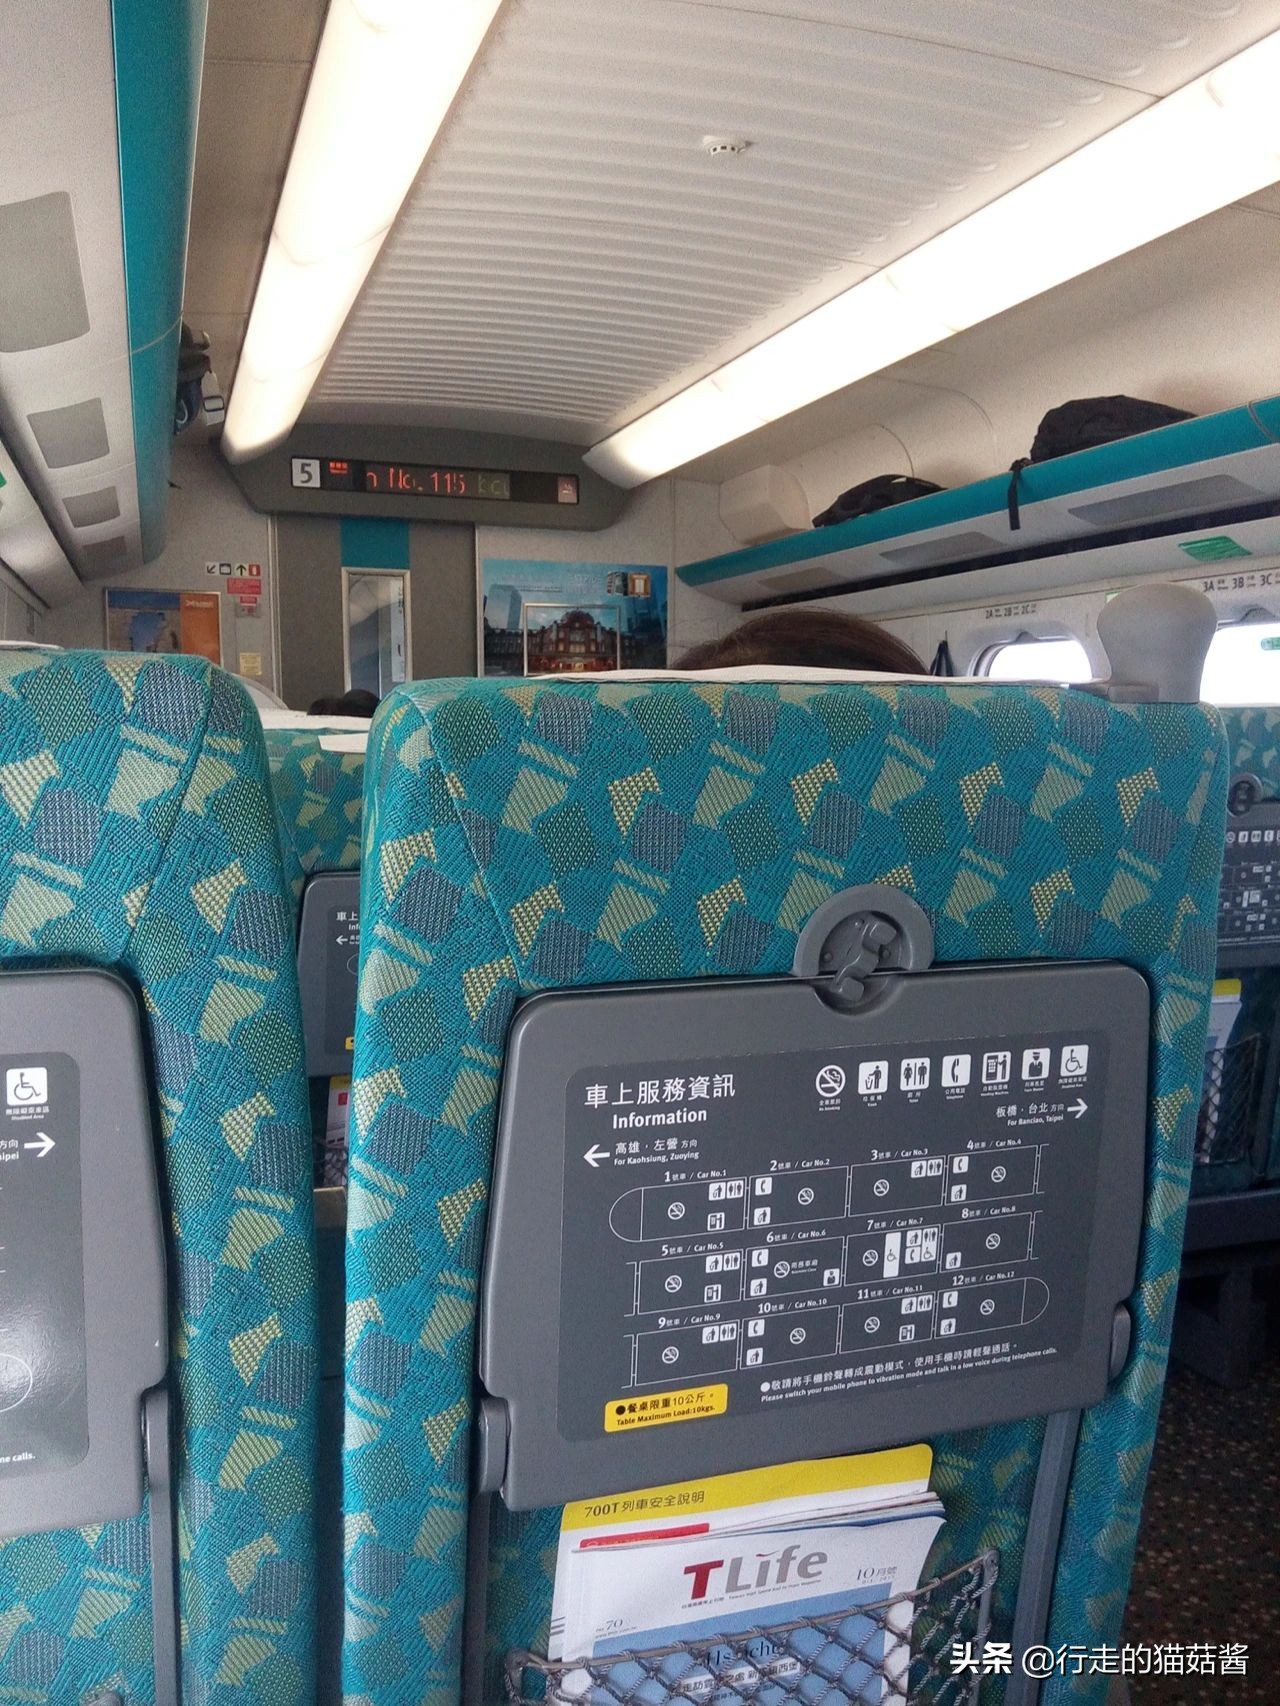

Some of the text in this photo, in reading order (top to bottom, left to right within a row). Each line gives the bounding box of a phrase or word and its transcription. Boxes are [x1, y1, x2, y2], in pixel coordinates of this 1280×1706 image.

[300, 462, 312, 483] 5
[430, 472, 466, 494] 115
[1232, 576, 1244, 590] 3B
[1260, 573, 1272, 586] 3C
[1203, 580, 1215, 592] 3A
[348, 923, 360, 931] Inf
[584, 1074, 736, 1109] 車上服務資訊
[612, 1108, 708, 1129] Information
[1046, 1113, 1064, 1122] Taipei
[681, 1139, 698, 1149] 方向
[614, 1151, 700, 1166] For Kaohsiung, Zuoying
[697, 1171, 709, 1179] Car
[896, 1219, 908, 1227] Car
[798, 1231, 809, 1239] Car
[694, 1244, 707, 1252] Car
[985, 1273, 996, 1281] Car
[892, 1287, 903, 1295] Car
[794, 1301, 806, 1309] Car
[691, 1316, 703, 1324] Car
[761, 1393, 784, 1402] Please
[784, 1390, 806, 1398] switch
[807, 1387, 822, 1396] your
[823, 1383, 846, 1392] mobile
[846, 1380, 867, 1389] phone
[876, 1373, 905, 1383] vibration
[905, 1370, 923, 1378] mode
[924, 1367, 936, 1375] and
[937, 1365, 950, 1373] talk
[991, 1356, 1011, 1364] during
[1012, 1351, 1042, 1360] telephone
[617, 1418, 636, 1426] Table
[637, 1412, 671, 1423] Maximum
[12, 1451, 36, 1461] calls.
[606, 1619, 623, 1631] 70
